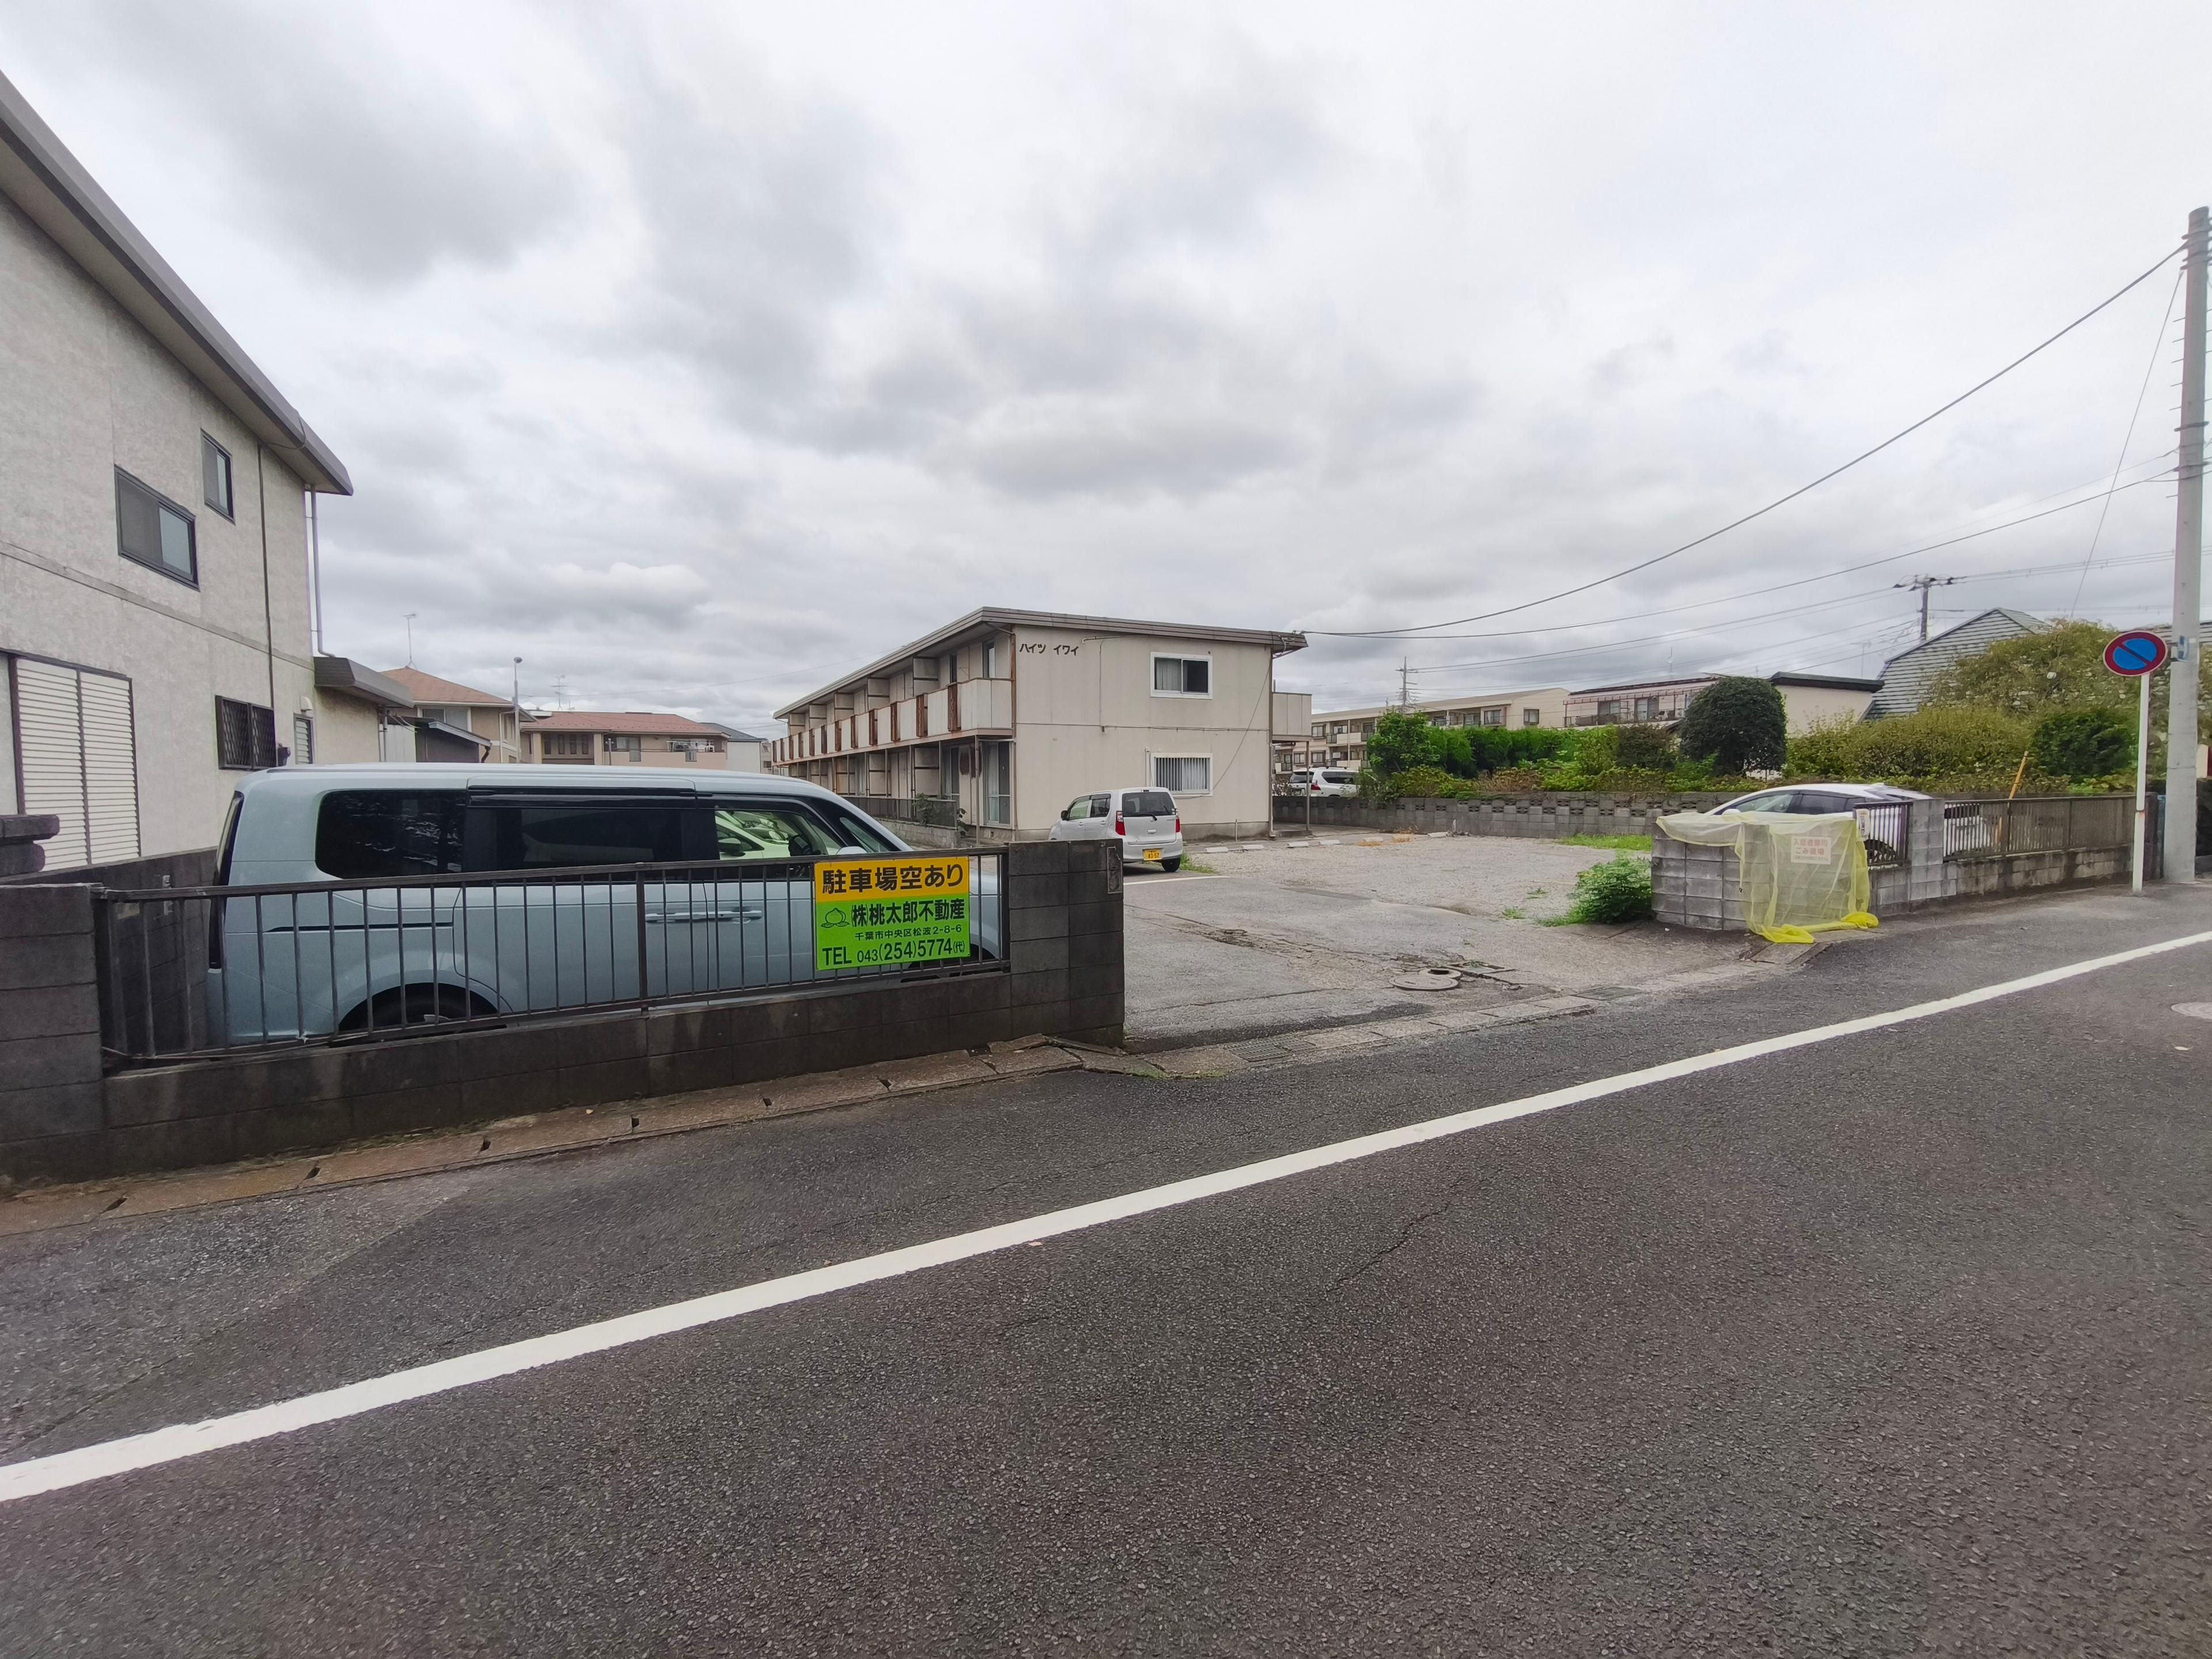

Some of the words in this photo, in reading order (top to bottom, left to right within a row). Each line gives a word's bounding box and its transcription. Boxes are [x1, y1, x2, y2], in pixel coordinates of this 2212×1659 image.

[1019, 643, 1046, 654] ハイツ
[1053, 645, 1079, 656] イワイ
[822, 863, 963, 894] 駐車場空あり
[854, 925, 962, 941] 千葉市中央区松波2-8-6
[822, 946, 852, 965] TEL
